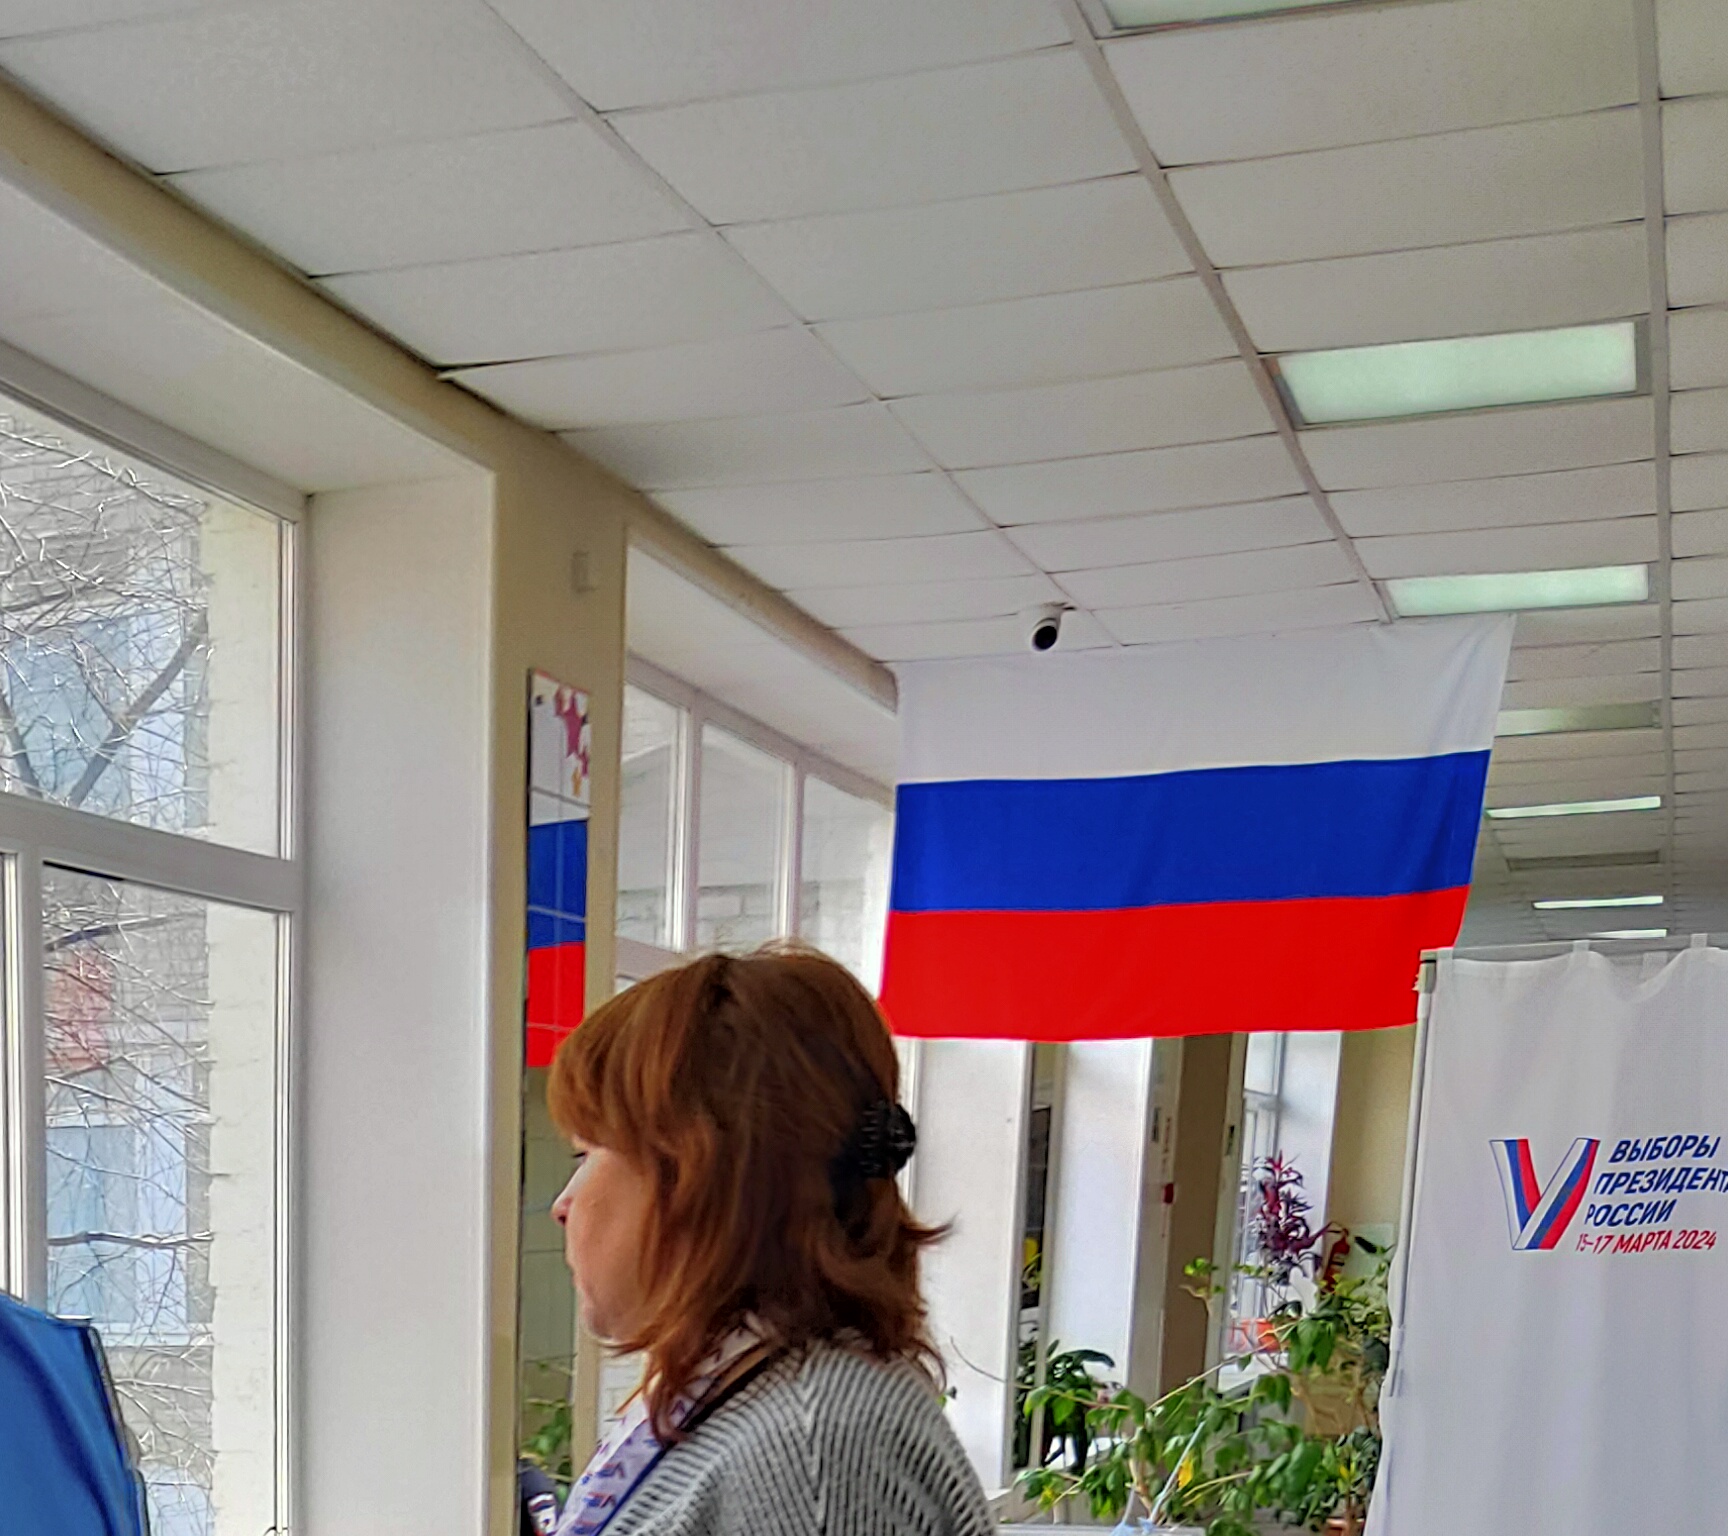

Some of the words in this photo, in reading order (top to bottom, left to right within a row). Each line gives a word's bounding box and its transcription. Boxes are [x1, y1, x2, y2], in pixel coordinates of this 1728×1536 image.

[1608, 1134, 1721, 1163] ВЫБОРЫ
[1584, 1198, 1677, 1227] РОССИИ
[1611, 1230, 1672, 1255] МАРТА
[1672, 1229, 1717, 1251] 2024
